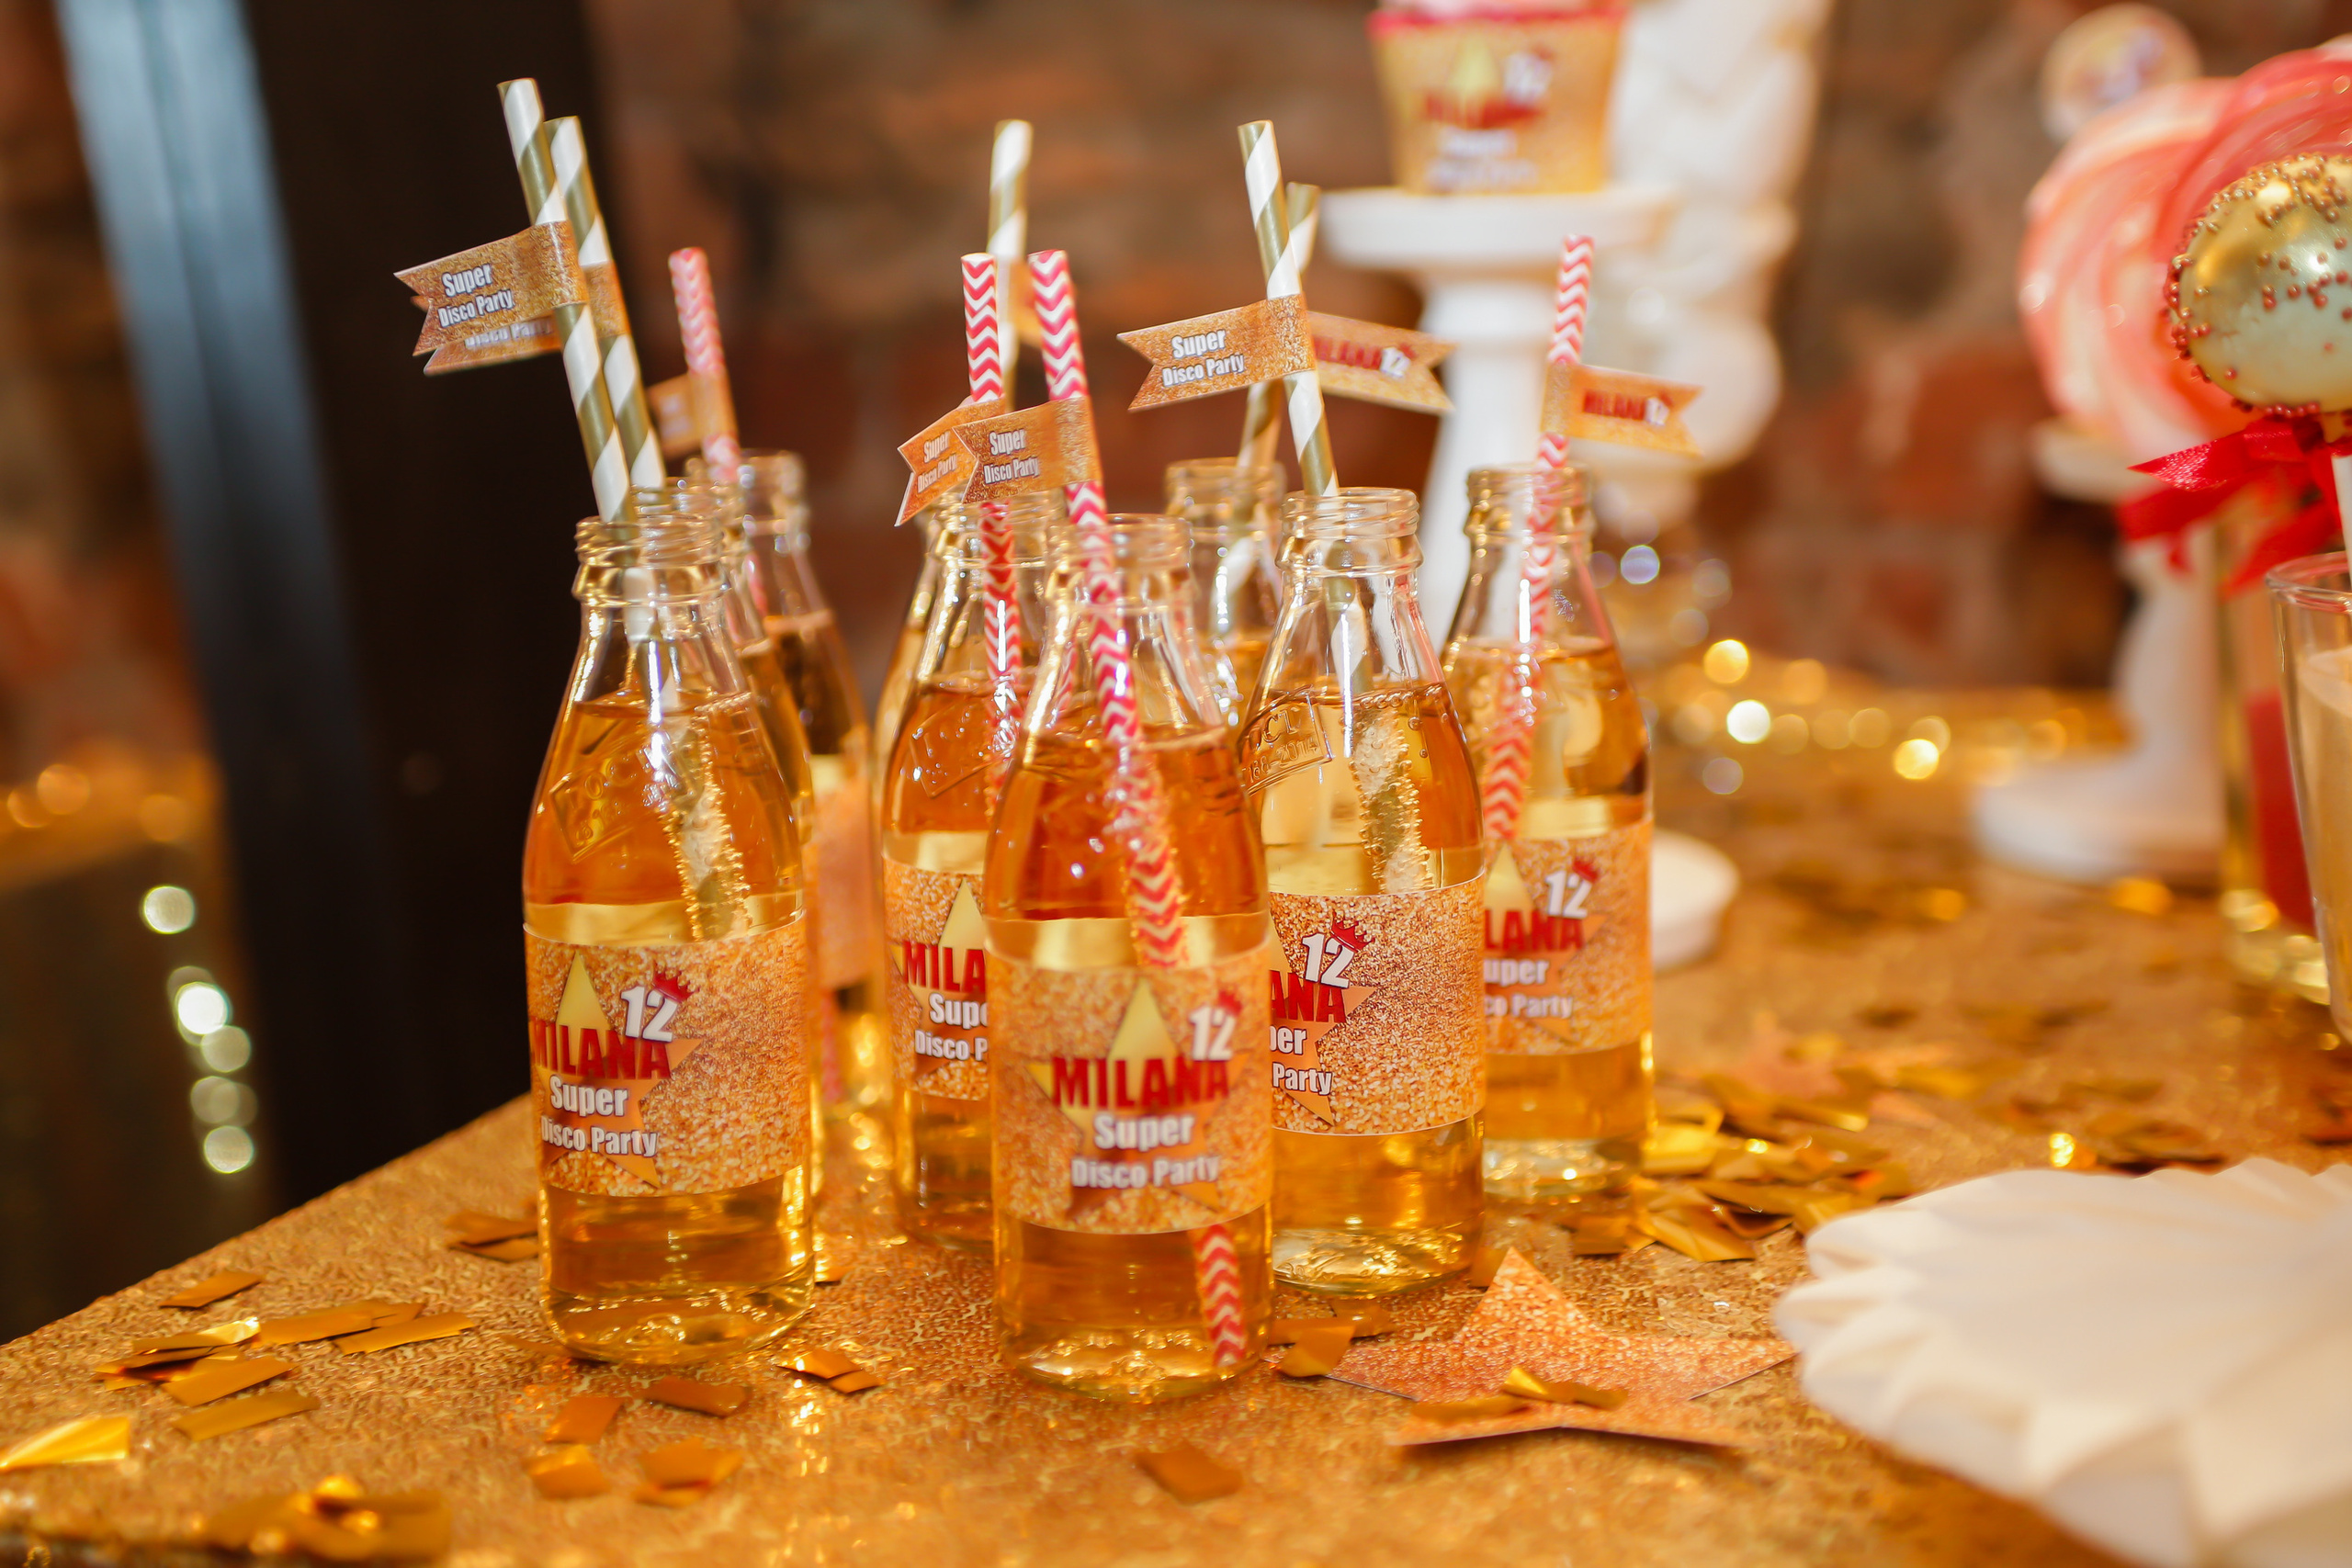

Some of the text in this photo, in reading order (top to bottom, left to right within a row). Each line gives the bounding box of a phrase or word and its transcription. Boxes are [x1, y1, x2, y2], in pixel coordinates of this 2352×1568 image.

[442, 263, 492, 298] Super
[438, 288, 514, 328] Disco Party
[1171, 329, 1226, 359] Super
[1162, 354, 1245, 387] Disco Party
[923, 431, 952, 463] Super
[989, 428, 1026, 456] Super
[918, 453, 957, 493] Disco Party
[983, 457, 1039, 484] Disco Party
[1544, 870, 1592, 919] 12
[1484, 908, 1586, 952] LANA
[902, 941, 987, 992] MILA
[1302, 932, 1355, 989] 12
[1484, 959, 1550, 987] uper
[620, 985, 679, 1042] 12
[928, 992, 988, 1030] Sup
[1269, 970, 1346, 1022] ANA
[1511, 992, 1573, 1020] Party
[914, 1029, 970, 1061] Disco
[1189, 1006, 1237, 1061] 12
[549, 1074, 628, 1117] Super
[1051, 1055, 1229, 1110] MILANA
[1272, 1062, 1333, 1096] Party
[540, 1114, 659, 1157] Disco Party
[1093, 1111, 1194, 1153] Super
[1070, 1155, 1221, 1190] Disco Party
